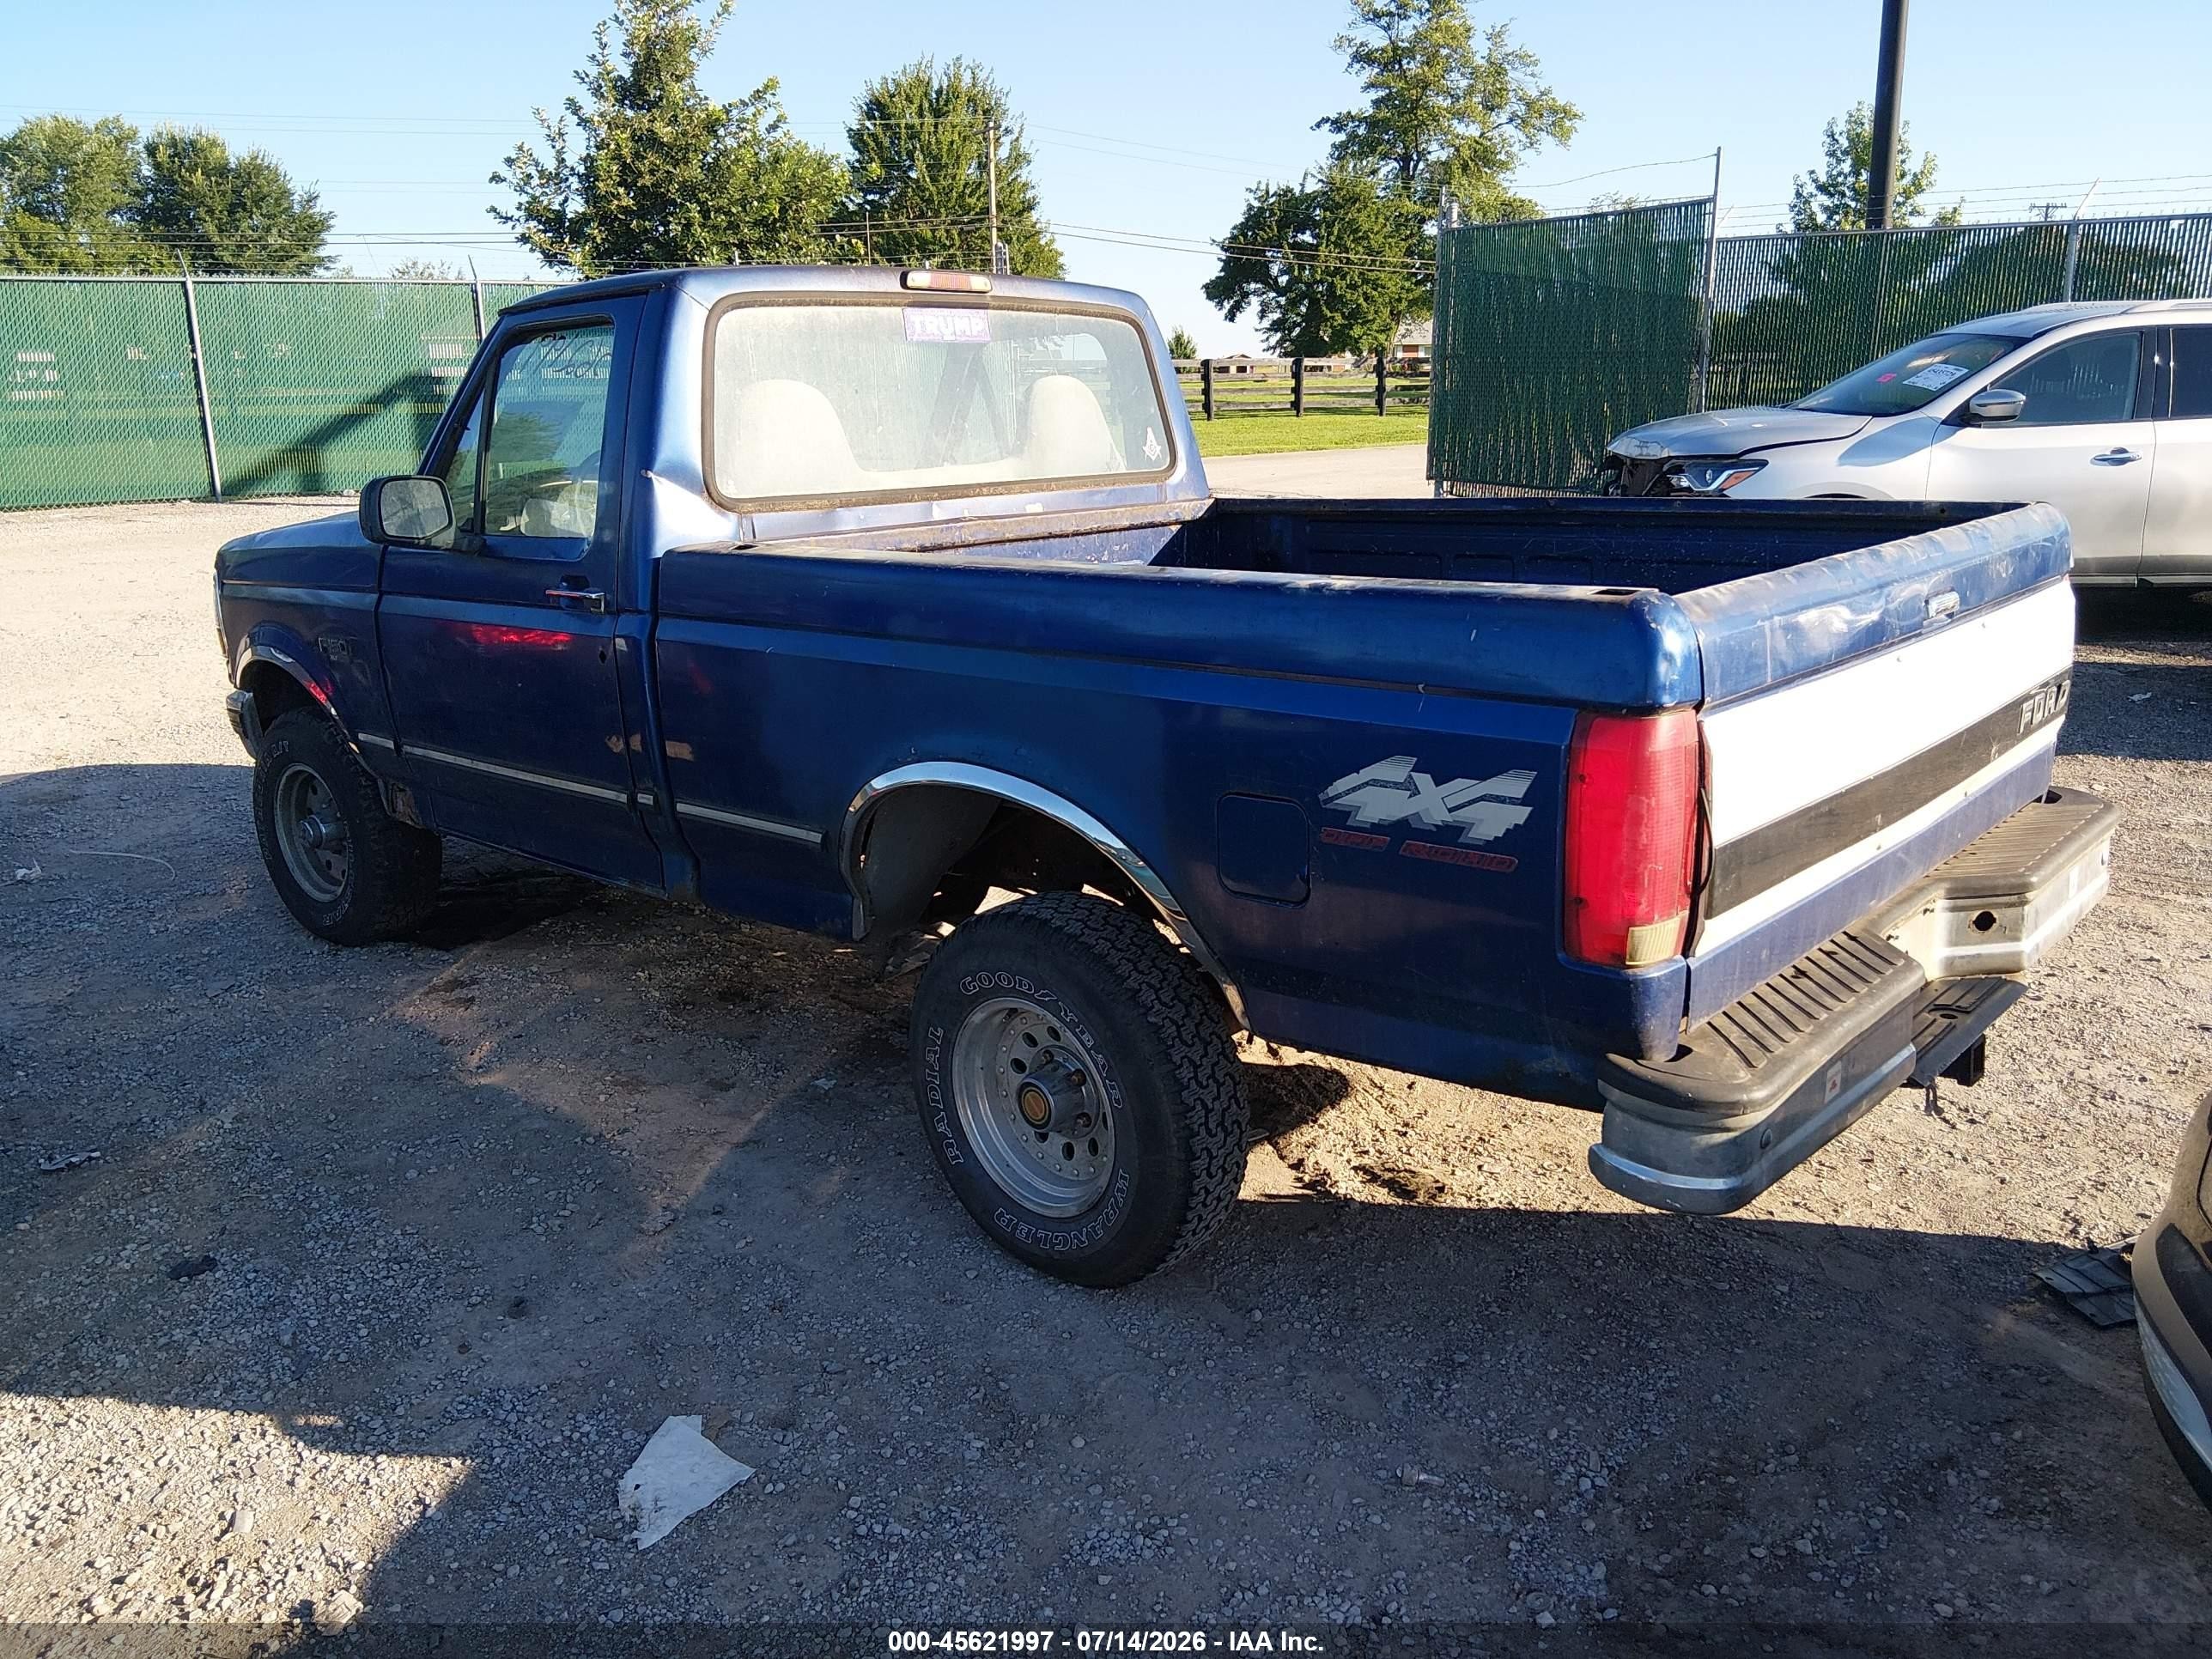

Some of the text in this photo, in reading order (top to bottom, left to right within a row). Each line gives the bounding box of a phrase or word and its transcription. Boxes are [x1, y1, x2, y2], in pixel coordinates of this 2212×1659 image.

[910, 315, 984, 337] TRUMP
[2018, 679, 2071, 735] FORD
[931, 1026, 965, 1165] RADIAL
[994, 1167, 1132, 1251] WRANGLER
